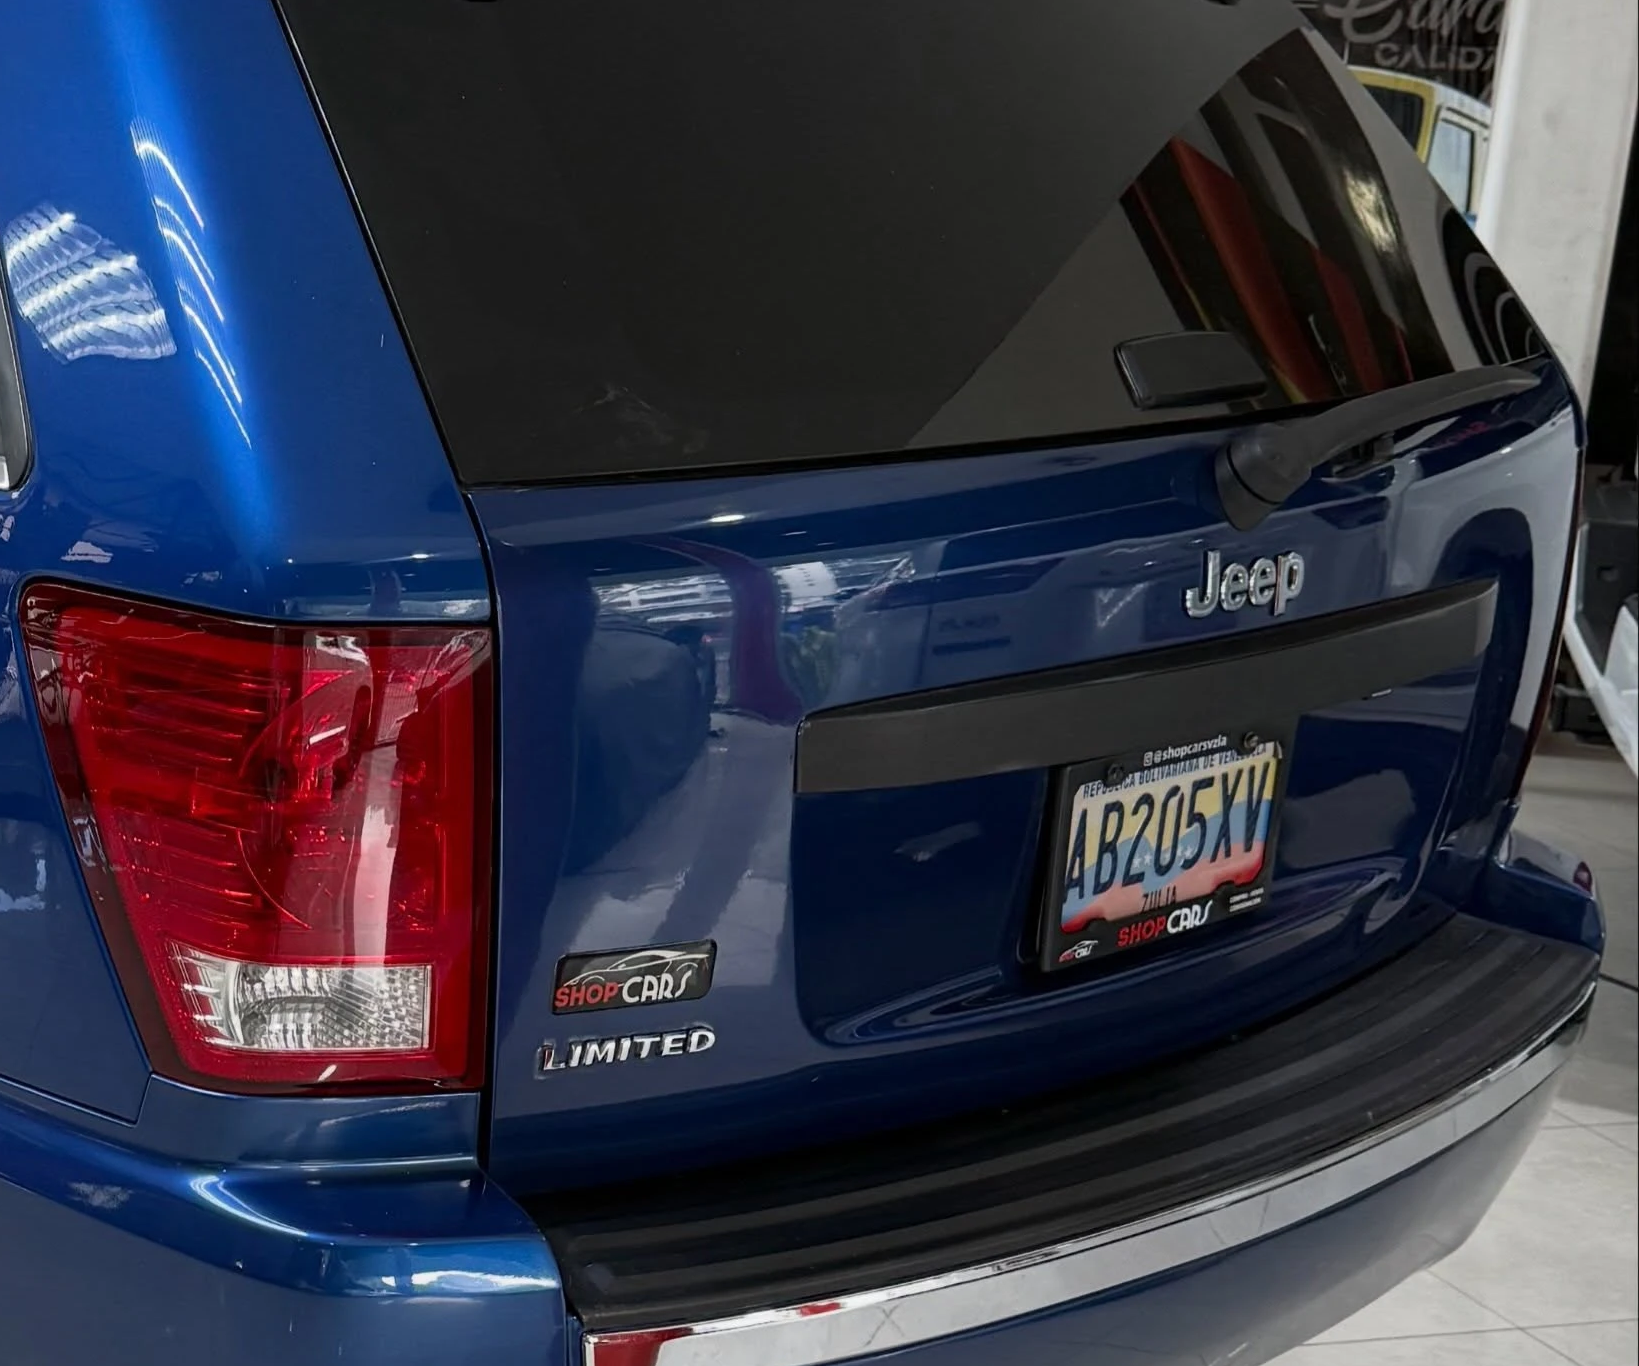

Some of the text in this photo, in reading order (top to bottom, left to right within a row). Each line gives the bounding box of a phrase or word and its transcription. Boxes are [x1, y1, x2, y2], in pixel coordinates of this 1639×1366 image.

[1185, 550, 1305, 618] Jeep
[1062, 761, 1270, 903] AB205XV
[1116, 915, 1167, 947] SHOP
[1166, 900, 1213, 934] CARS
[554, 970, 693, 1008] SHOP CARS
[539, 1029, 716, 1071] LIMITED
